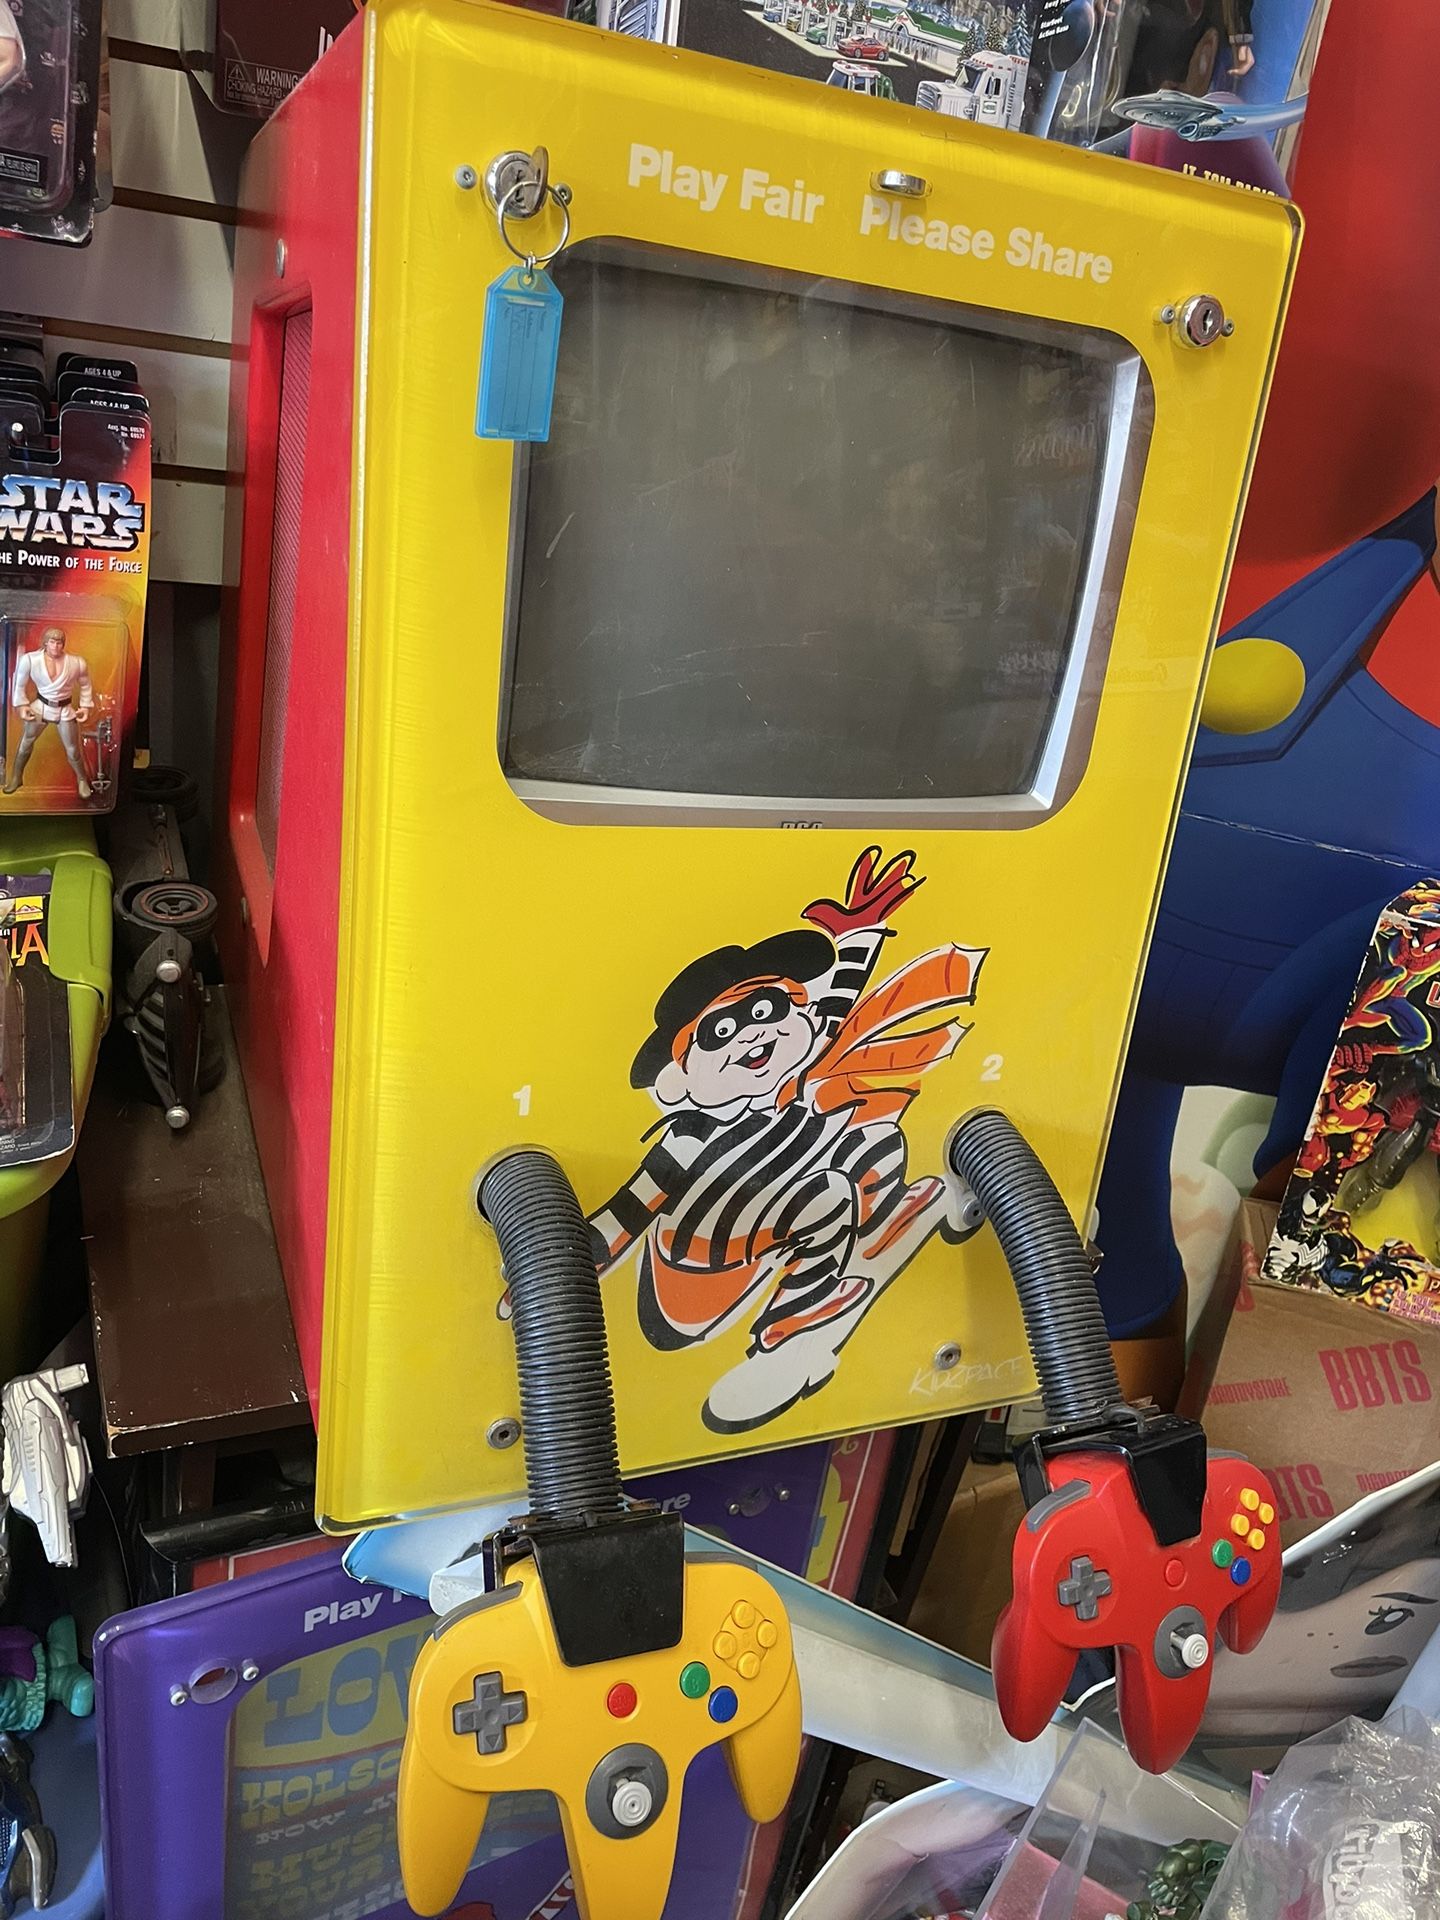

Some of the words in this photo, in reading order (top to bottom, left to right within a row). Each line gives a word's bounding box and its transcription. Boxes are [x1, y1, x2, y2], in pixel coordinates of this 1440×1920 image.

[256, 67, 299, 89] WARNING
[257, 86, 282, 98] HAZARD
[628, 143, 728, 212] Play
[739, 168, 825, 224] Fair
[860, 195, 995, 259] Please
[1005, 227, 1113, 283] Share
[0, 474, 142, 518] STAR
[0, 508, 142, 548] WARS
[0, 552, 12, 564] HE
[18, 550, 60, 567] POWER
[65, 557, 79, 568] OF
[84, 558, 104, 570] THE
[109, 556, 142, 573] FORCE
[981, 1054, 1003, 1081] 2
[513, 1085, 532, 1115] 1
[1318, 1340, 1432, 1411] BBTS
[304, 1592, 383, 1633] Play
